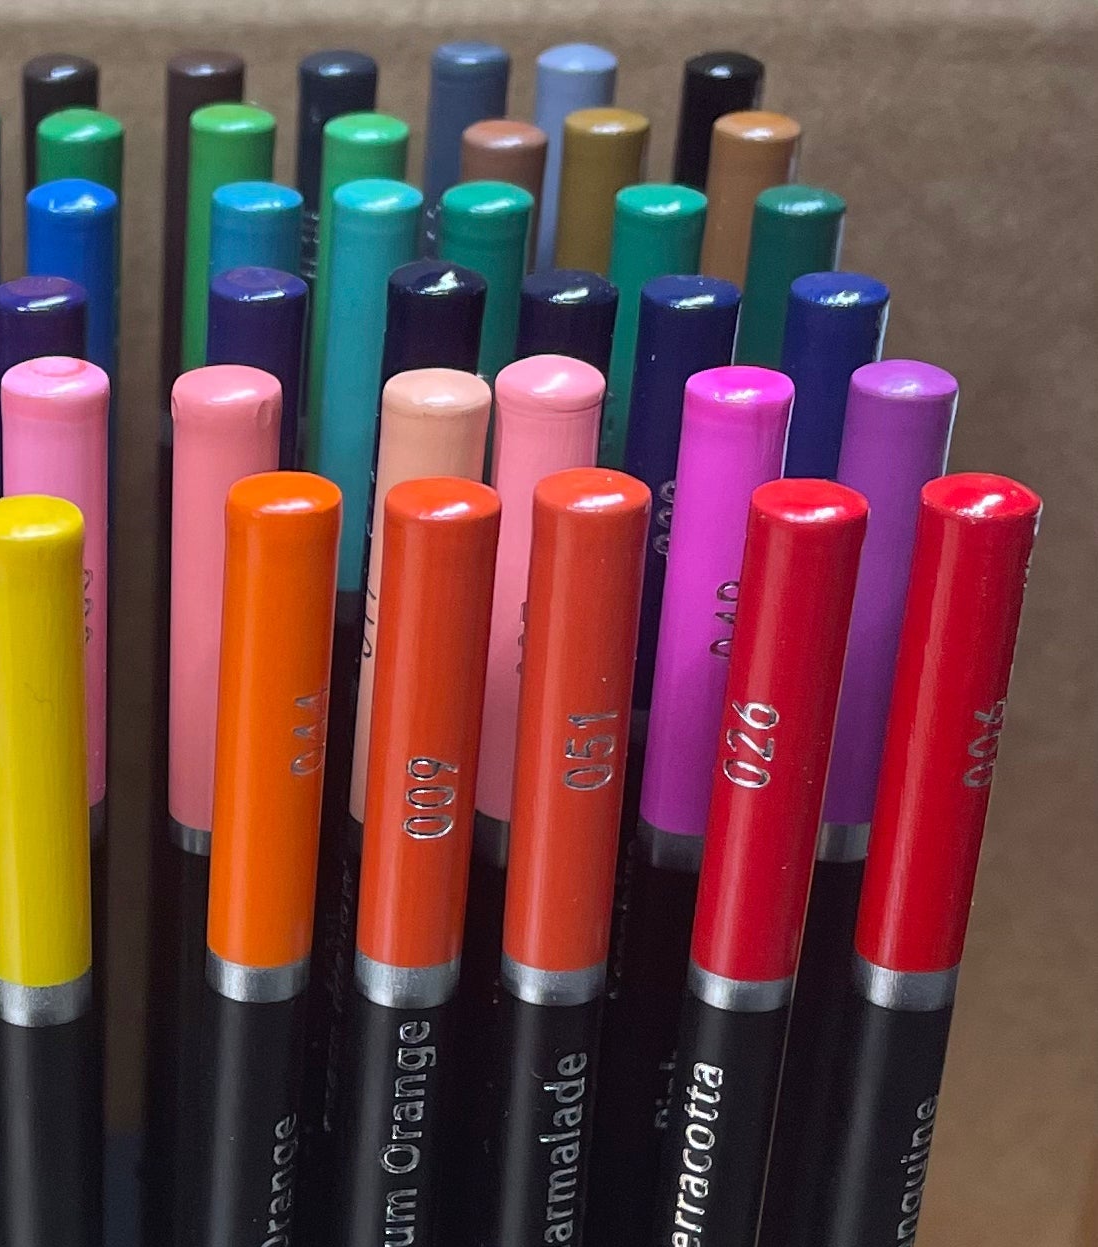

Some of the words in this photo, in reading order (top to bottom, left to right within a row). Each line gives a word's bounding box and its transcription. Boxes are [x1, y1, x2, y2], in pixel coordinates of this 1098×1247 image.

[562, 710, 619, 792] 051
[722, 700, 780, 789] 026
[402, 756, 459, 840] 009
[380, 1020, 437, 1175] Orange
